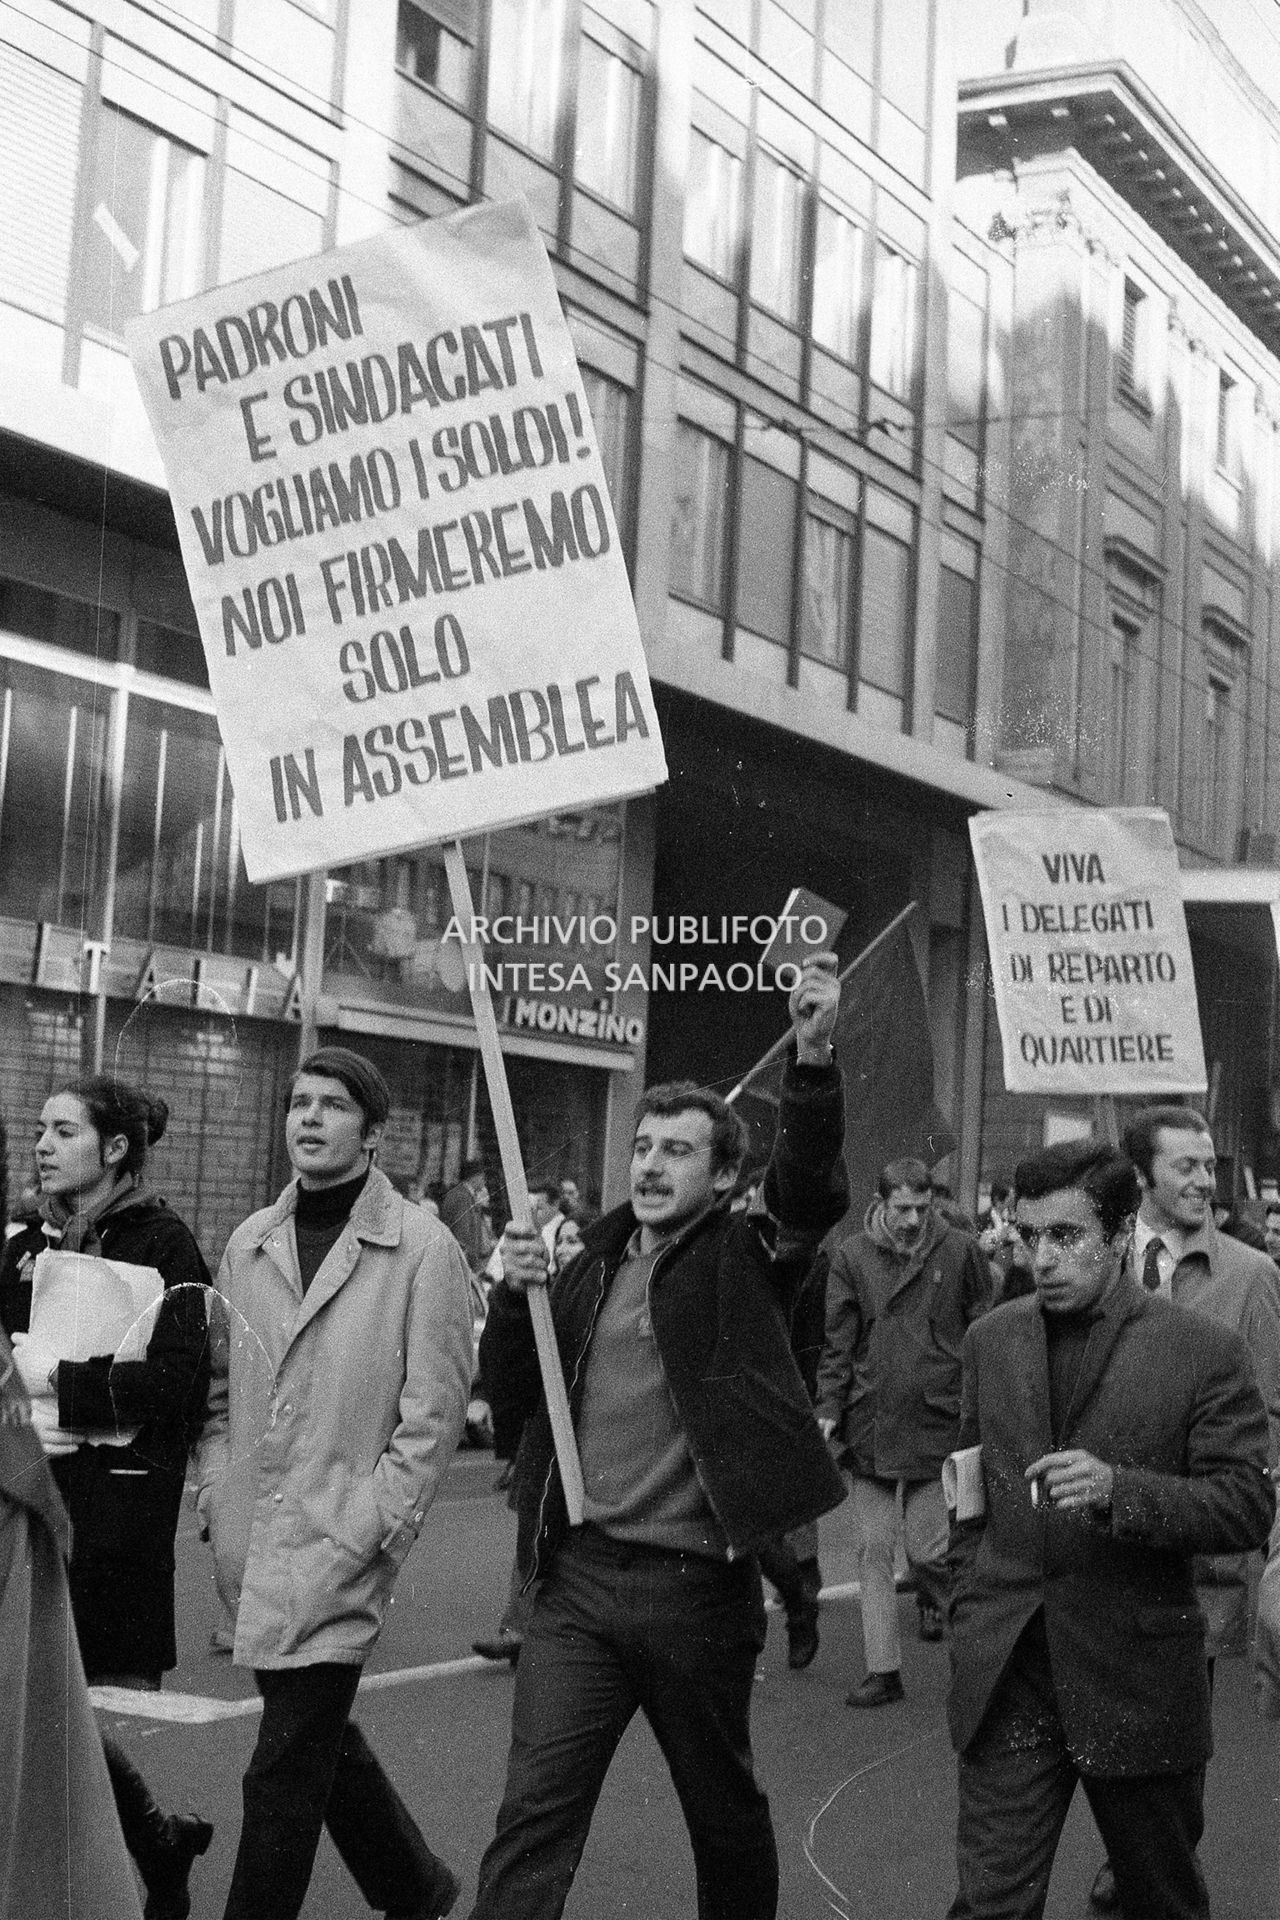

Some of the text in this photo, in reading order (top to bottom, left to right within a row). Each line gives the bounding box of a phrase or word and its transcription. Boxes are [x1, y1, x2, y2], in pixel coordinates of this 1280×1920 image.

[158, 275, 364, 400] PADRONI
[239, 313, 543, 464] E SINDACATI
[190, 391, 592, 566] VOGLIAMO I SOLDI!
[219, 483, 612, 657] NOI FIRMEREMO
[338, 613, 472, 703] SOLO
[268, 671, 650, 824] IN ASSEMBLEA
[1042, 853, 1106, 884] VIVA
[1001, 900, 1154, 934] I DELEGATI
[1010, 951, 1177, 985] DI REPARTO
[1060, 996, 1113, 1024] E DI
[1020, 1032, 1175, 1067] QUARTIERE
